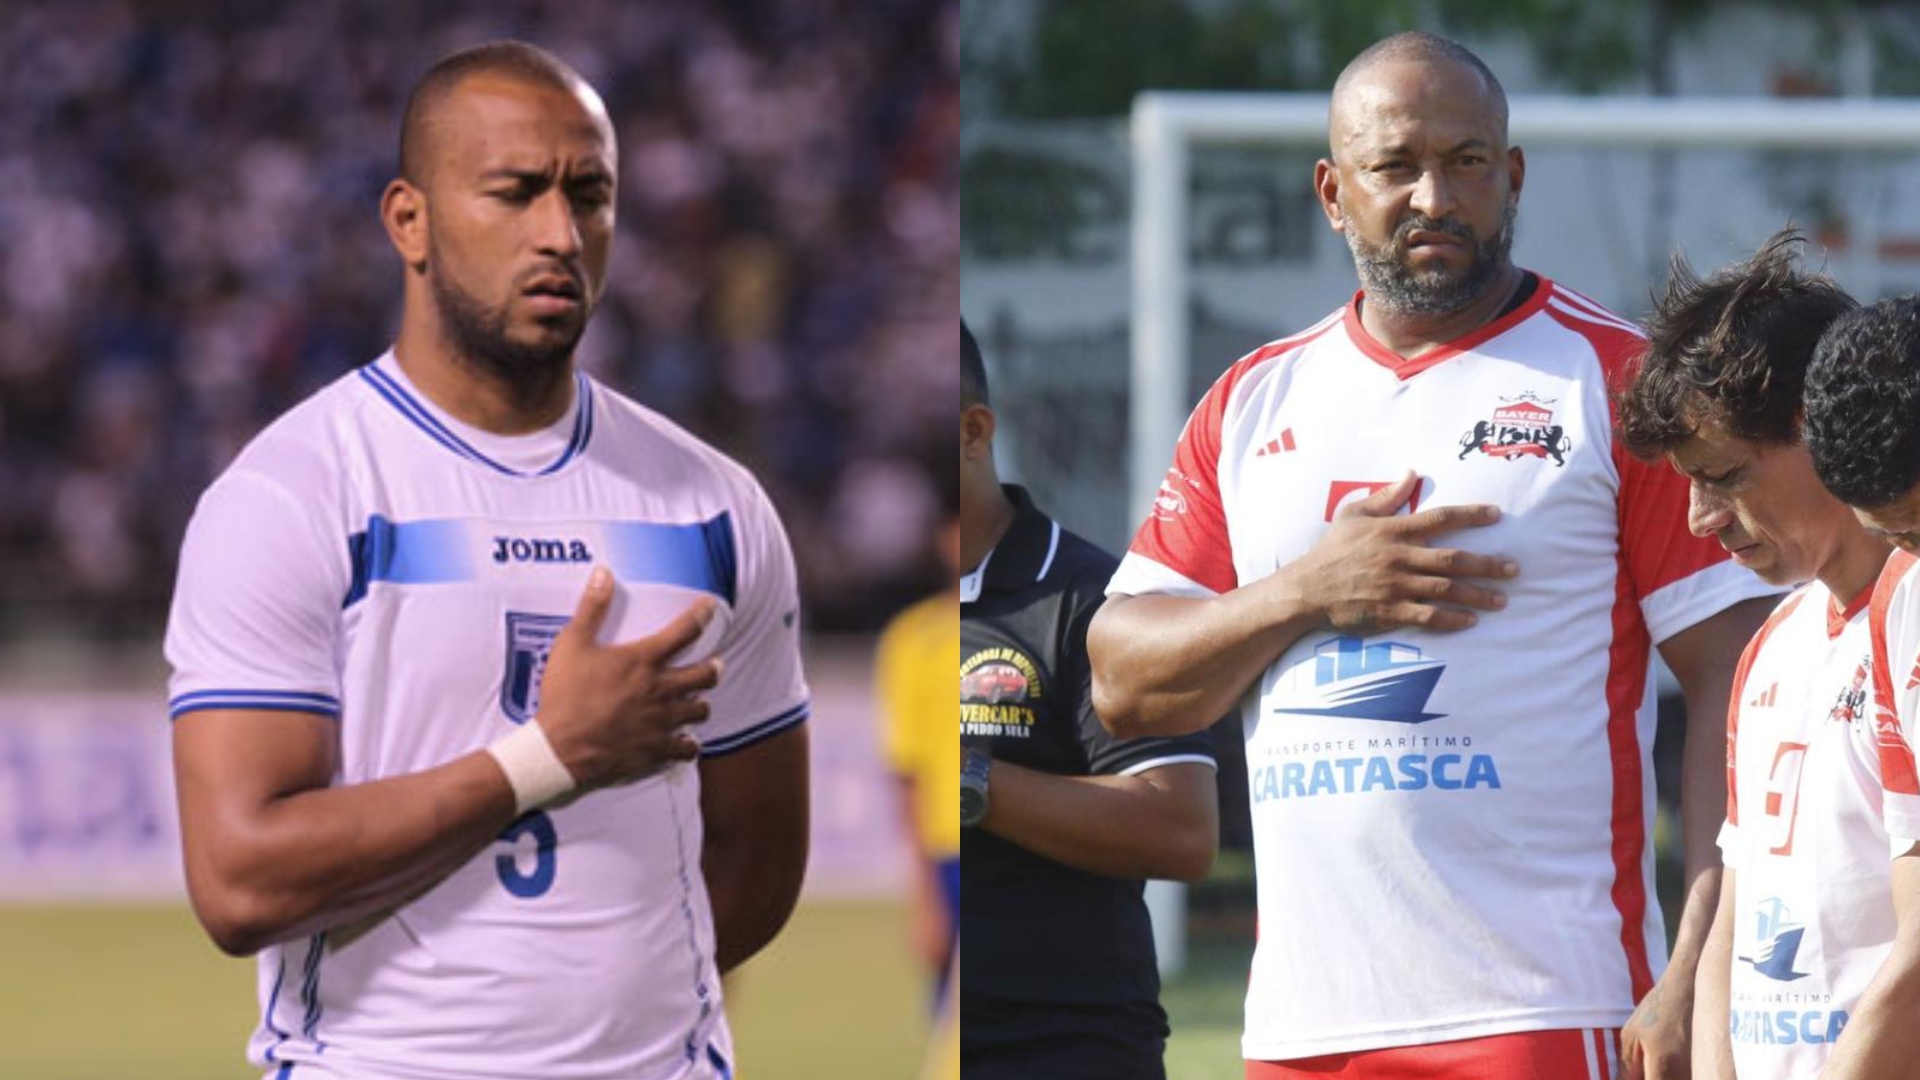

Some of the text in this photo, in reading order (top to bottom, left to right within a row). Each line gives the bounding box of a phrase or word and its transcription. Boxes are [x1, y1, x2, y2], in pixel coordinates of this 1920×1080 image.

[1495, 410, 1552, 422] BAYER
[966, 723, 1002, 736] PEDRO
[1005, 726, 1030, 738] SULA
[1368, 736, 1472, 749] MARÍTIMO
[1253, 754, 1502, 804] CARATASCA
